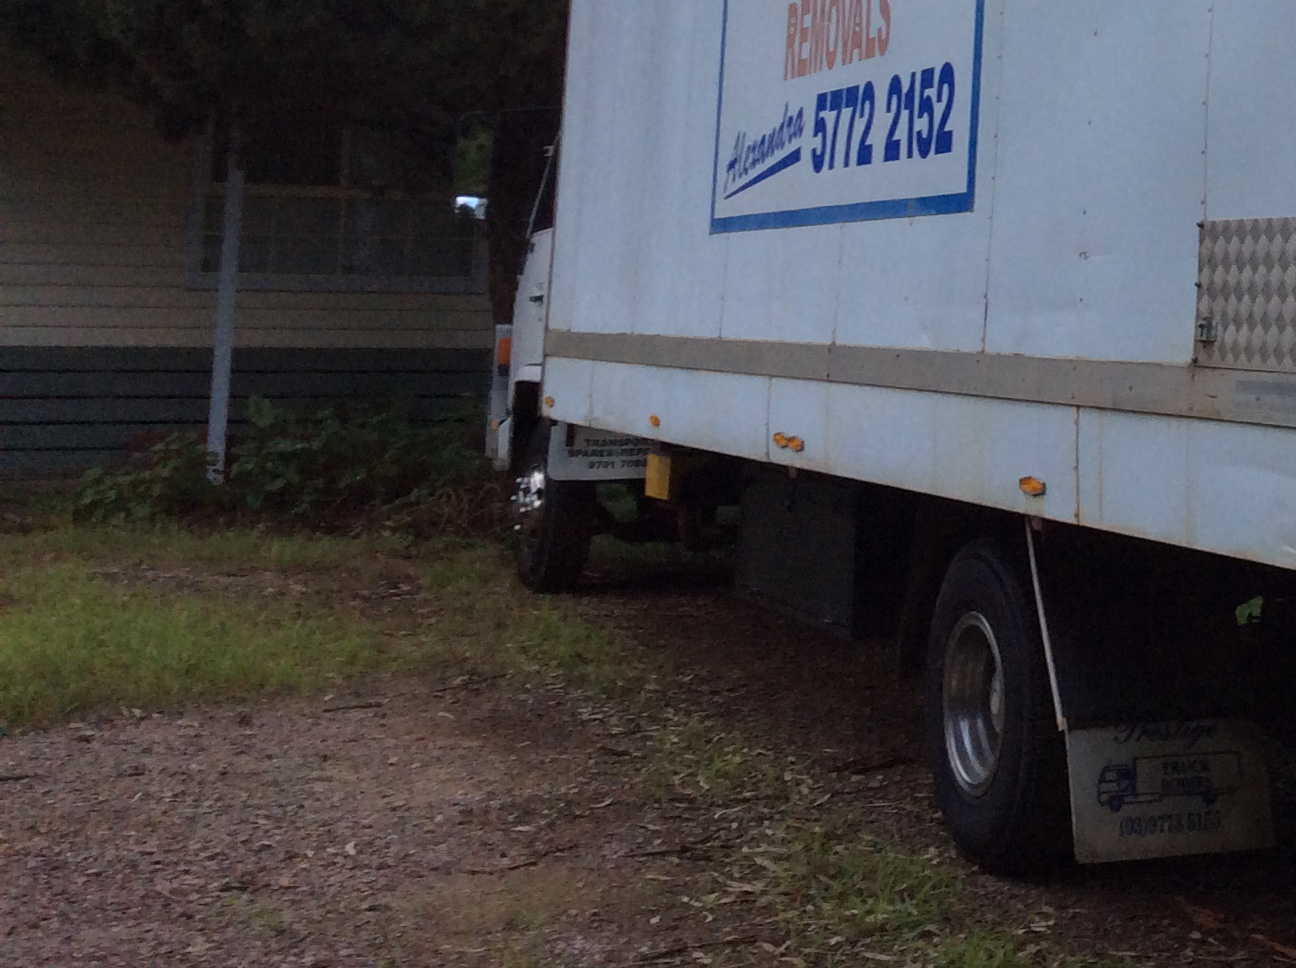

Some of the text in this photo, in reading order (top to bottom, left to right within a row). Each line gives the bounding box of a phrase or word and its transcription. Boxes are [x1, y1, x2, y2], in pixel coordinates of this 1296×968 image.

[723, 61, 956, 193] Alexandra 5772 2152
